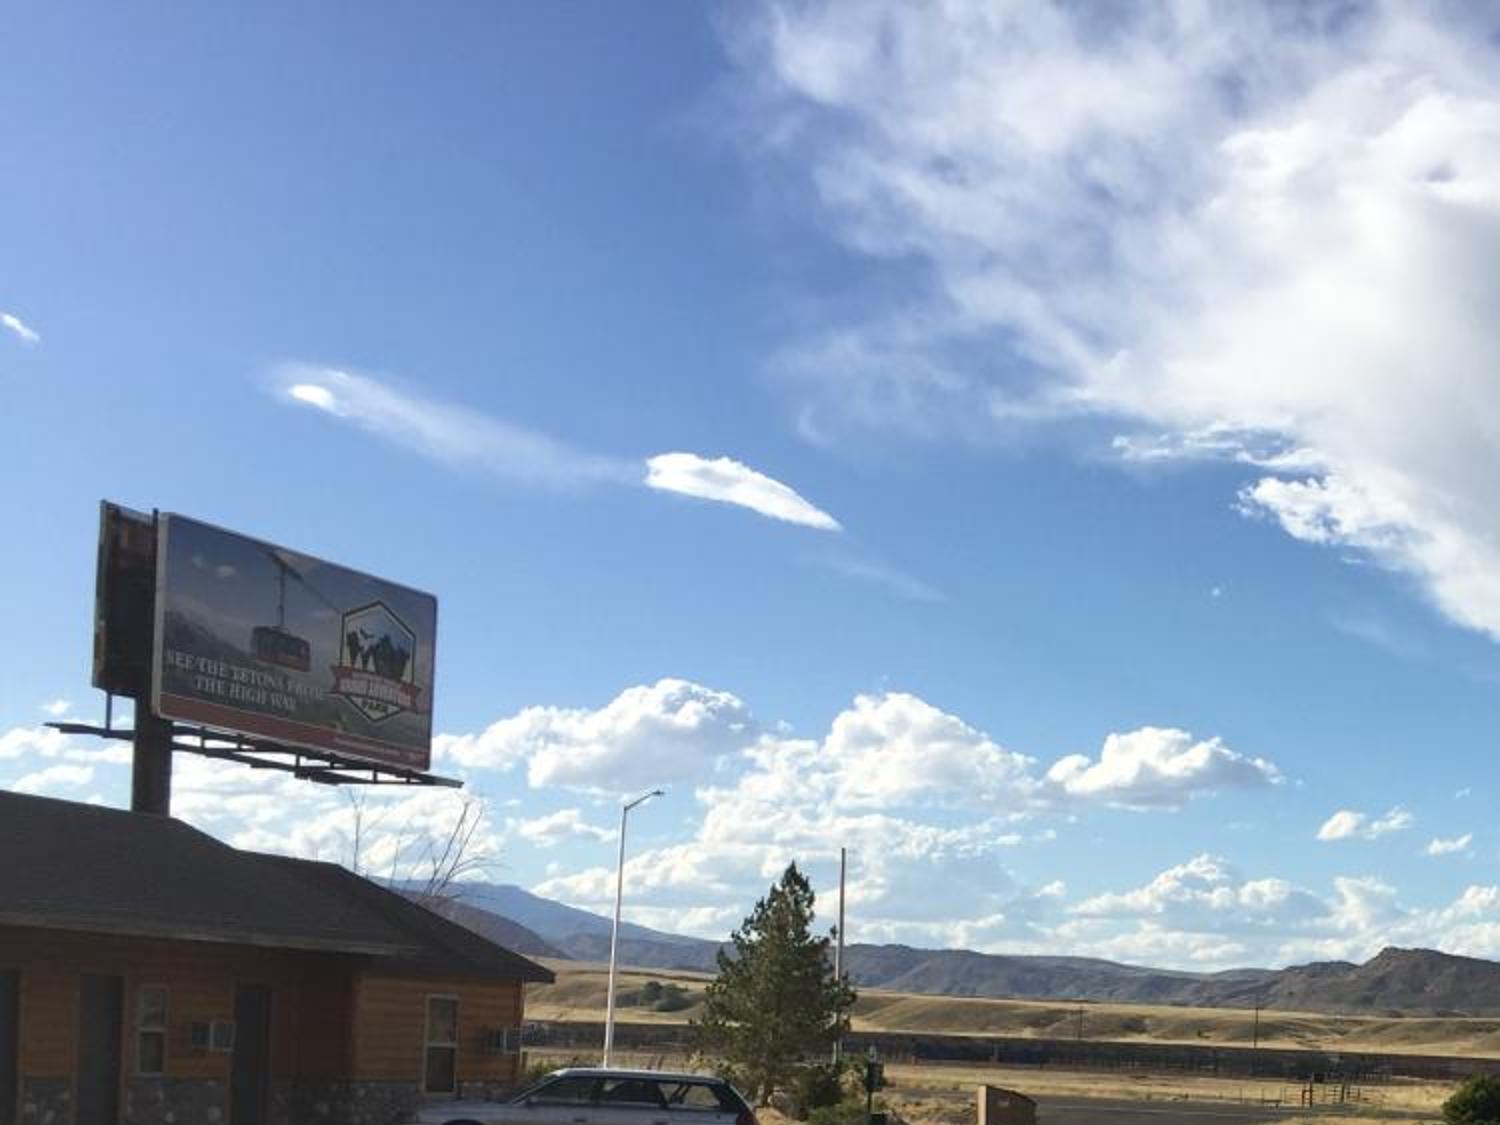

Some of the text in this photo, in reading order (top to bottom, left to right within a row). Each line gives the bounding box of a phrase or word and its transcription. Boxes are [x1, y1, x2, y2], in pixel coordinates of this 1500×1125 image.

[197, 656, 227, 677] THE
[194, 674, 225, 695] THE
[229, 683, 267, 705] HIGH
